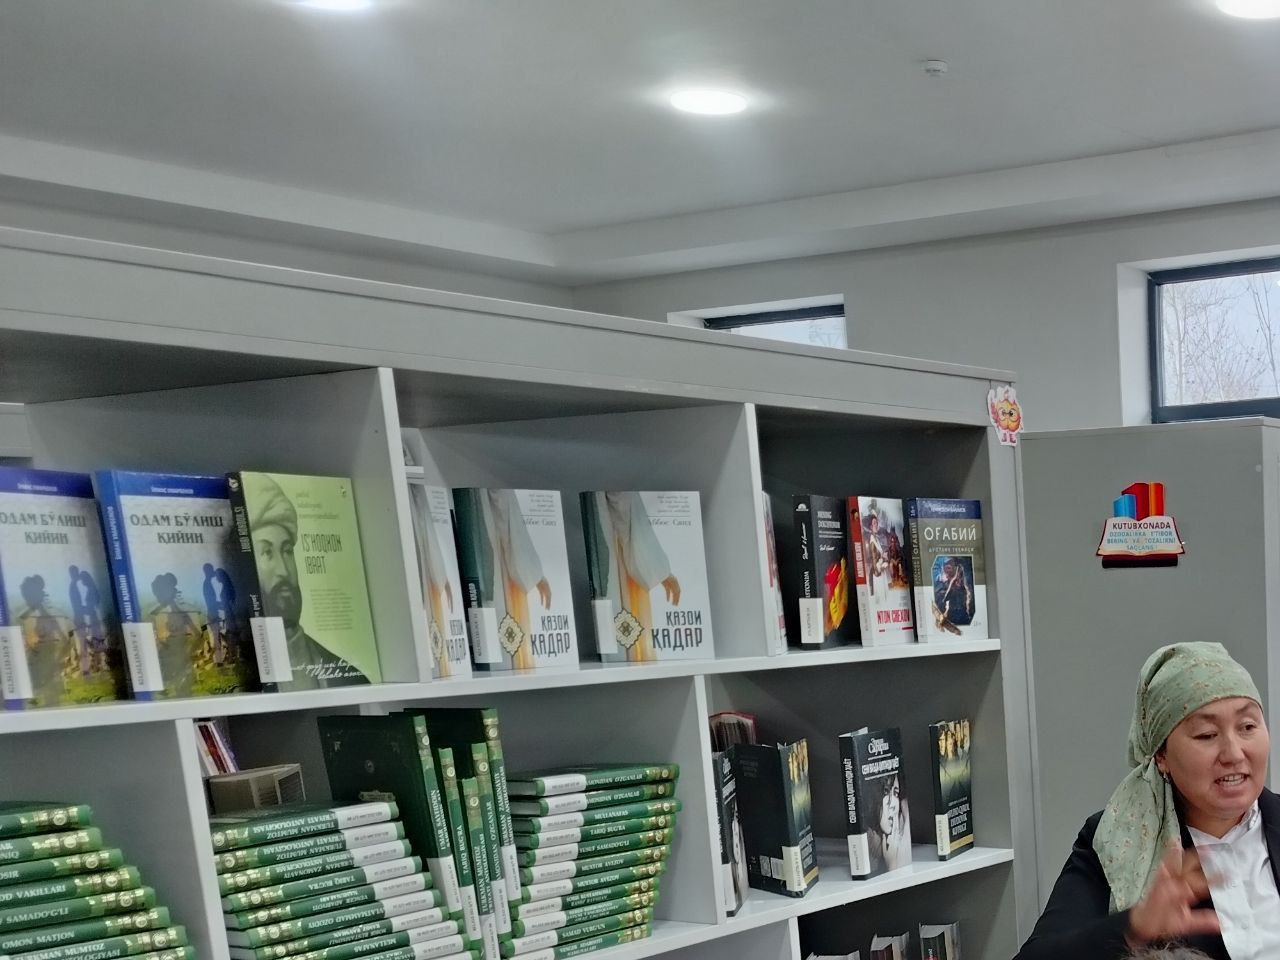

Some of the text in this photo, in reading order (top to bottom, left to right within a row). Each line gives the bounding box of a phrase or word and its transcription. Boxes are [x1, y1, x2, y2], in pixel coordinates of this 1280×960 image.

[130, 512, 224, 528] ОДАМ БЎЛИШ
[1112, 521, 1171, 530] KUTUBXONADA
[158, 531, 204, 545] ҚИЙИН
[924, 524, 977, 541] ОҒАБИЙ
[2, 938, 33, 949] OMON
